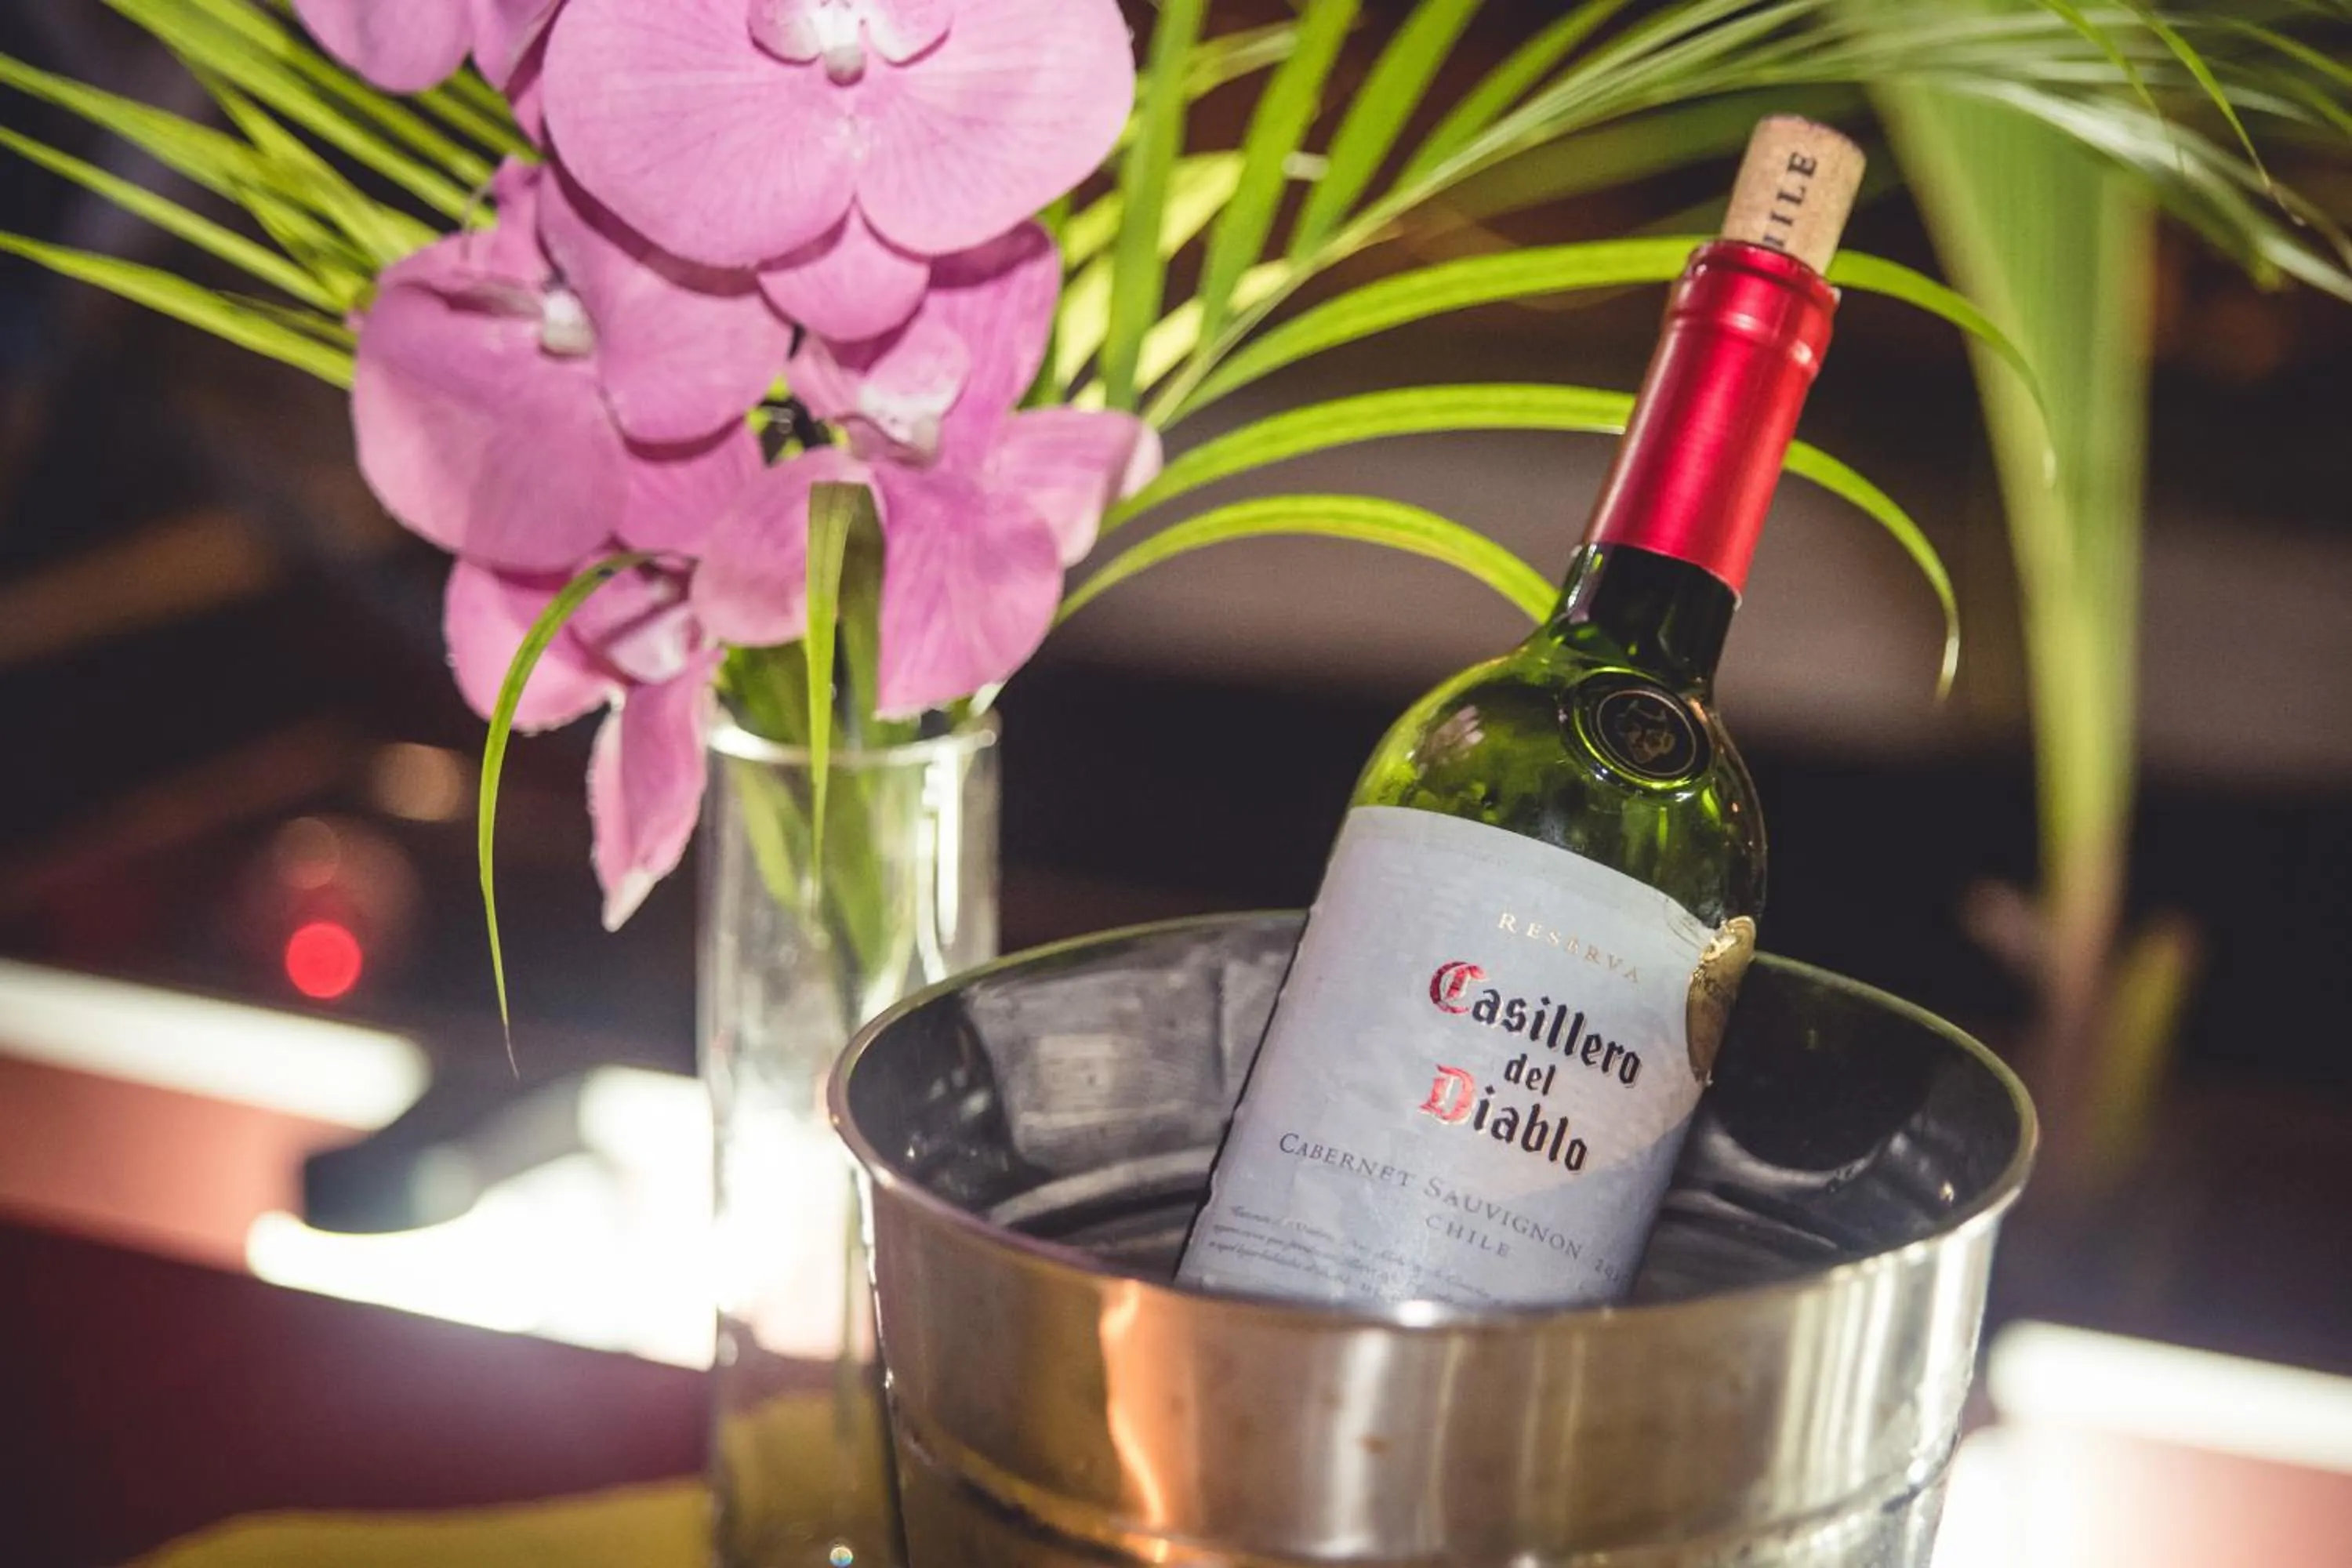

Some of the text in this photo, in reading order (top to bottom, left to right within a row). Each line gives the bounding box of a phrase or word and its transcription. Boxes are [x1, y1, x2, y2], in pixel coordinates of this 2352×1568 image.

[1499, 913, 1639, 982] RESERVA
[1430, 961, 1640, 1086] Casillero
[1504, 1053, 1556, 1095] del
[1420, 1065, 1588, 1172] Diablo
[1279, 1133, 1414, 1187] CABERNET
[1424, 1178, 1582, 1259] SAUVIGNON
[1425, 1216, 1510, 1259] CHILE
